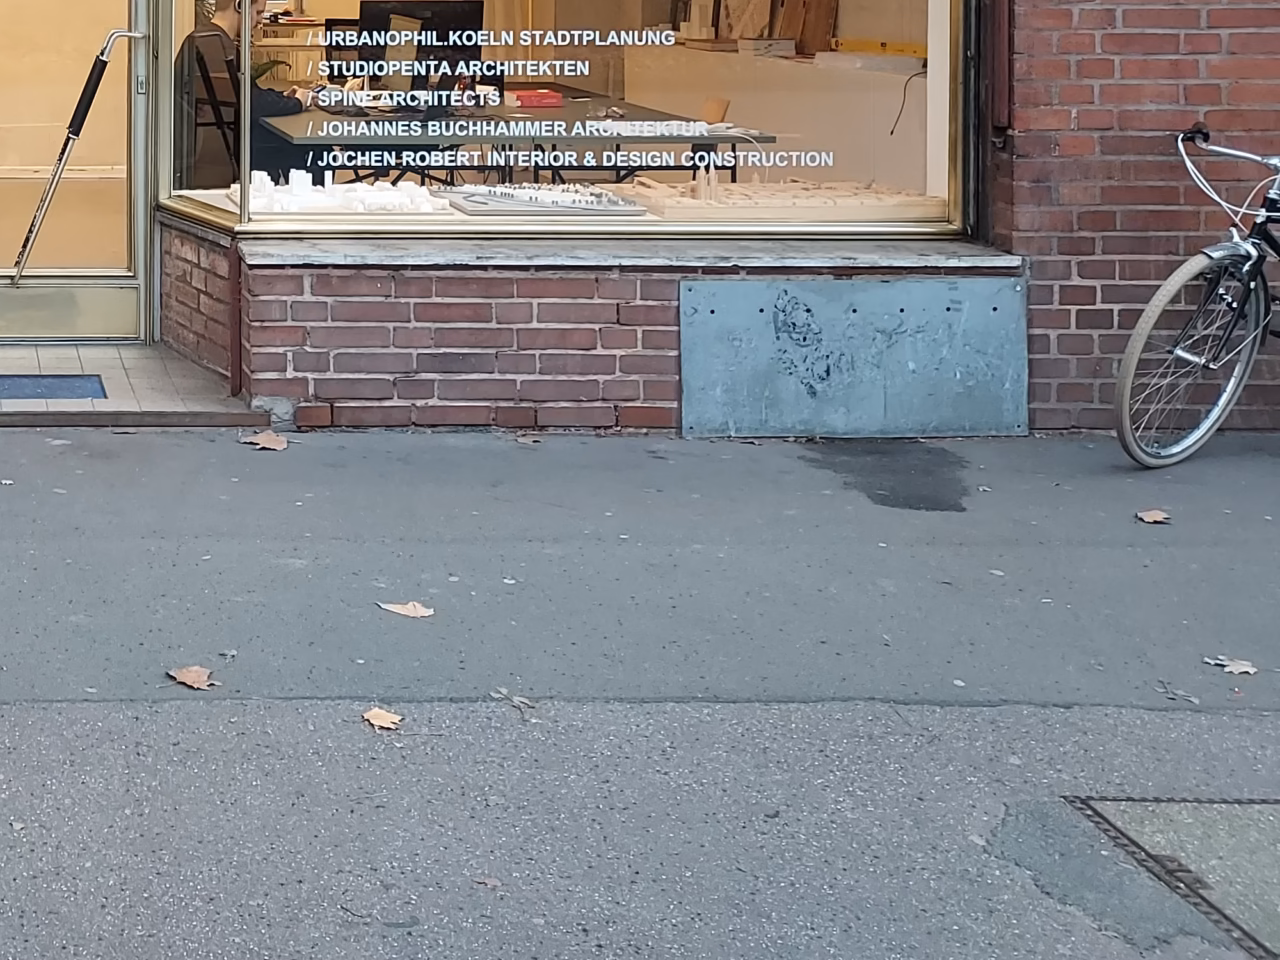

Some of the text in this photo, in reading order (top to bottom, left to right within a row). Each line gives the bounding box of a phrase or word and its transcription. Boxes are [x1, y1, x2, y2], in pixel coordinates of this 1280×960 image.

[317, 30, 514, 46] URBANOPHIL.KOELN
[519, 30, 676, 46] STADTPLANUNG
[317, 60, 452, 76] STUDIOPENTA
[454, 60, 590, 76] ARCHITEKTEN
[317, 90, 376, 107] SPINE
[379, 90, 501, 107] ARCHITECTS
[317, 121, 422, 137] JOHANNES
[427, 120, 568, 137] BUCHHAMMER
[317, 151, 396, 167] JOCHEN
[402, 151, 482, 167] ROBERT
[487, 151, 578, 167] INTERIOR
[583, 151, 597, 167] &
[602, 151, 675, 167] DESIGN
[681, 151, 834, 167] CONSTRUCTION
